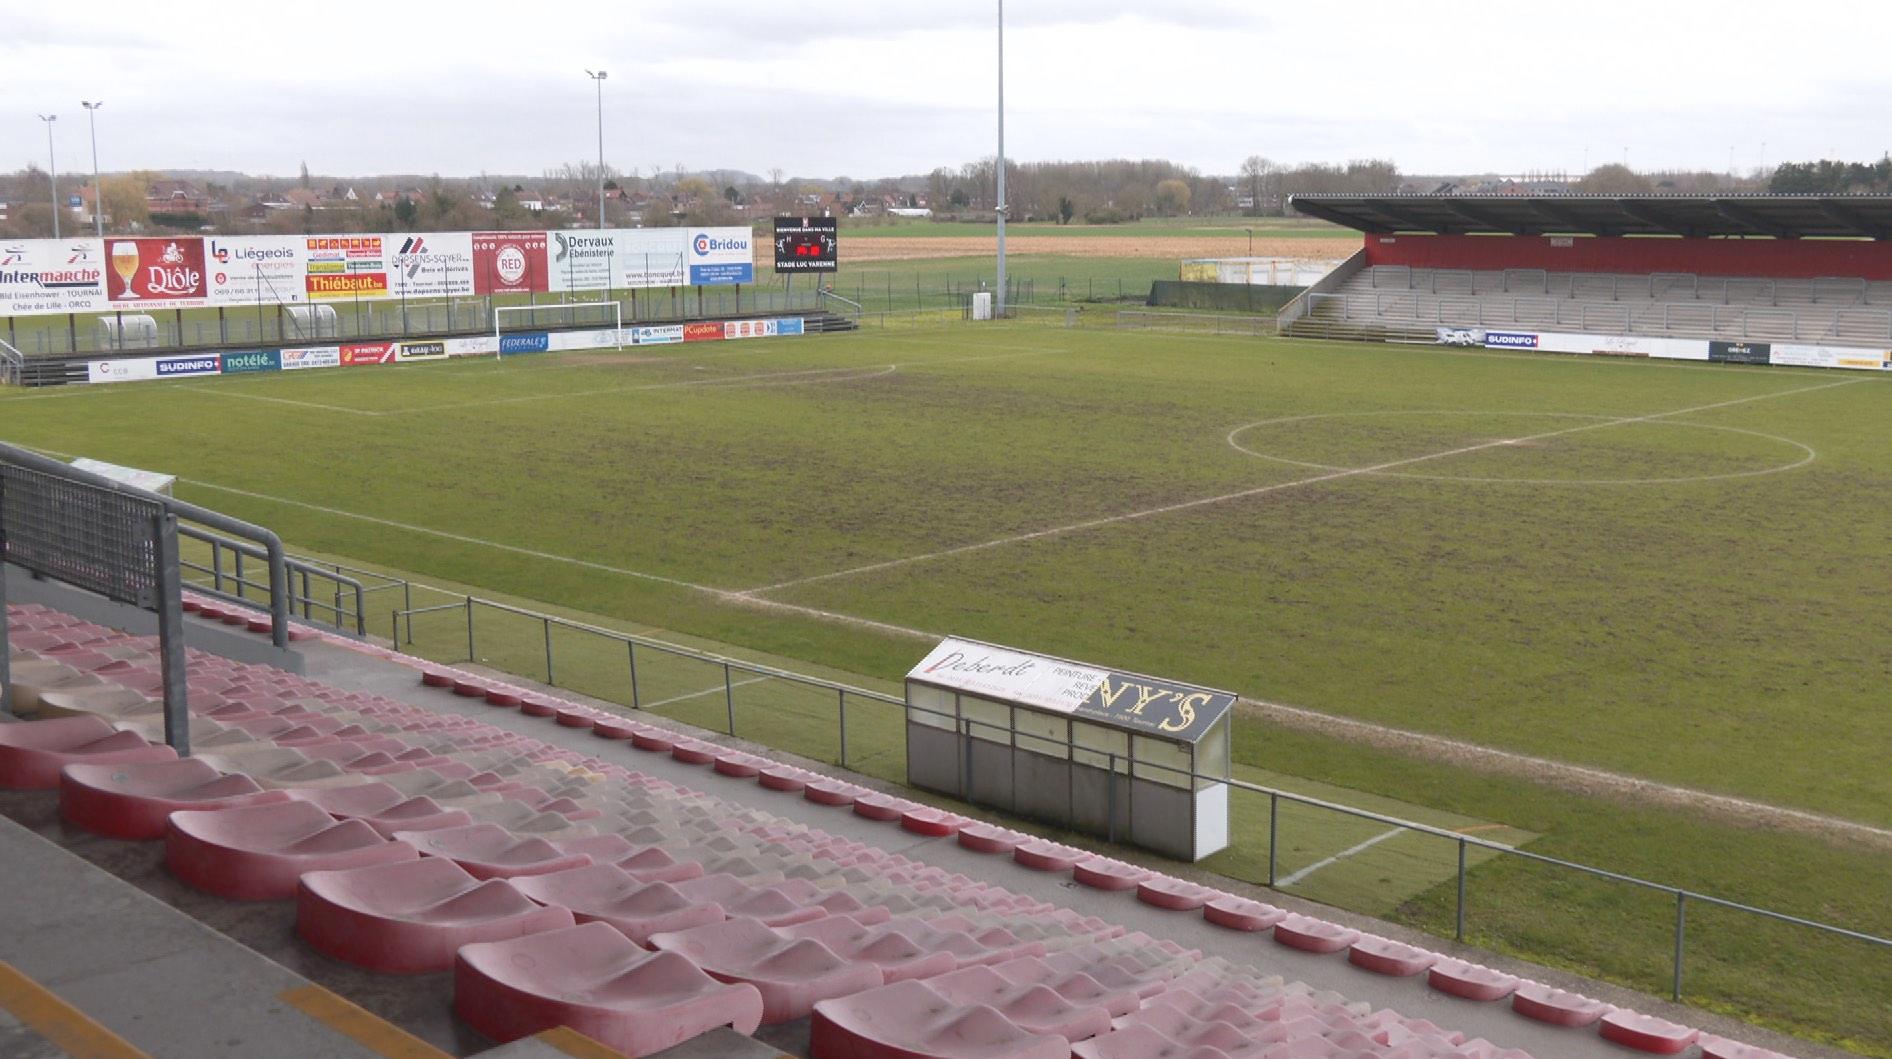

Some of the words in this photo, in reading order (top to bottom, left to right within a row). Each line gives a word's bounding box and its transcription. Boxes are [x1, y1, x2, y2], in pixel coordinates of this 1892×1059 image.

[569, 236, 613, 247] Dervaux
[709, 239, 747, 250] Bridou
[235, 247, 294, 261] Liégeois
[501, 259, 522, 270] RED
[0, 268, 100, 287] Intermarché
[147, 266, 200, 295] Diôle
[15, 290, 60, 299] Eisenhower
[67, 289, 102, 297] TOURNAI
[35, 301, 44, 309] de
[502, 338, 539, 348] FEDERALE
[1488, 335, 1532, 345] SUDINFO
[160, 361, 213, 372] SUDINFO
